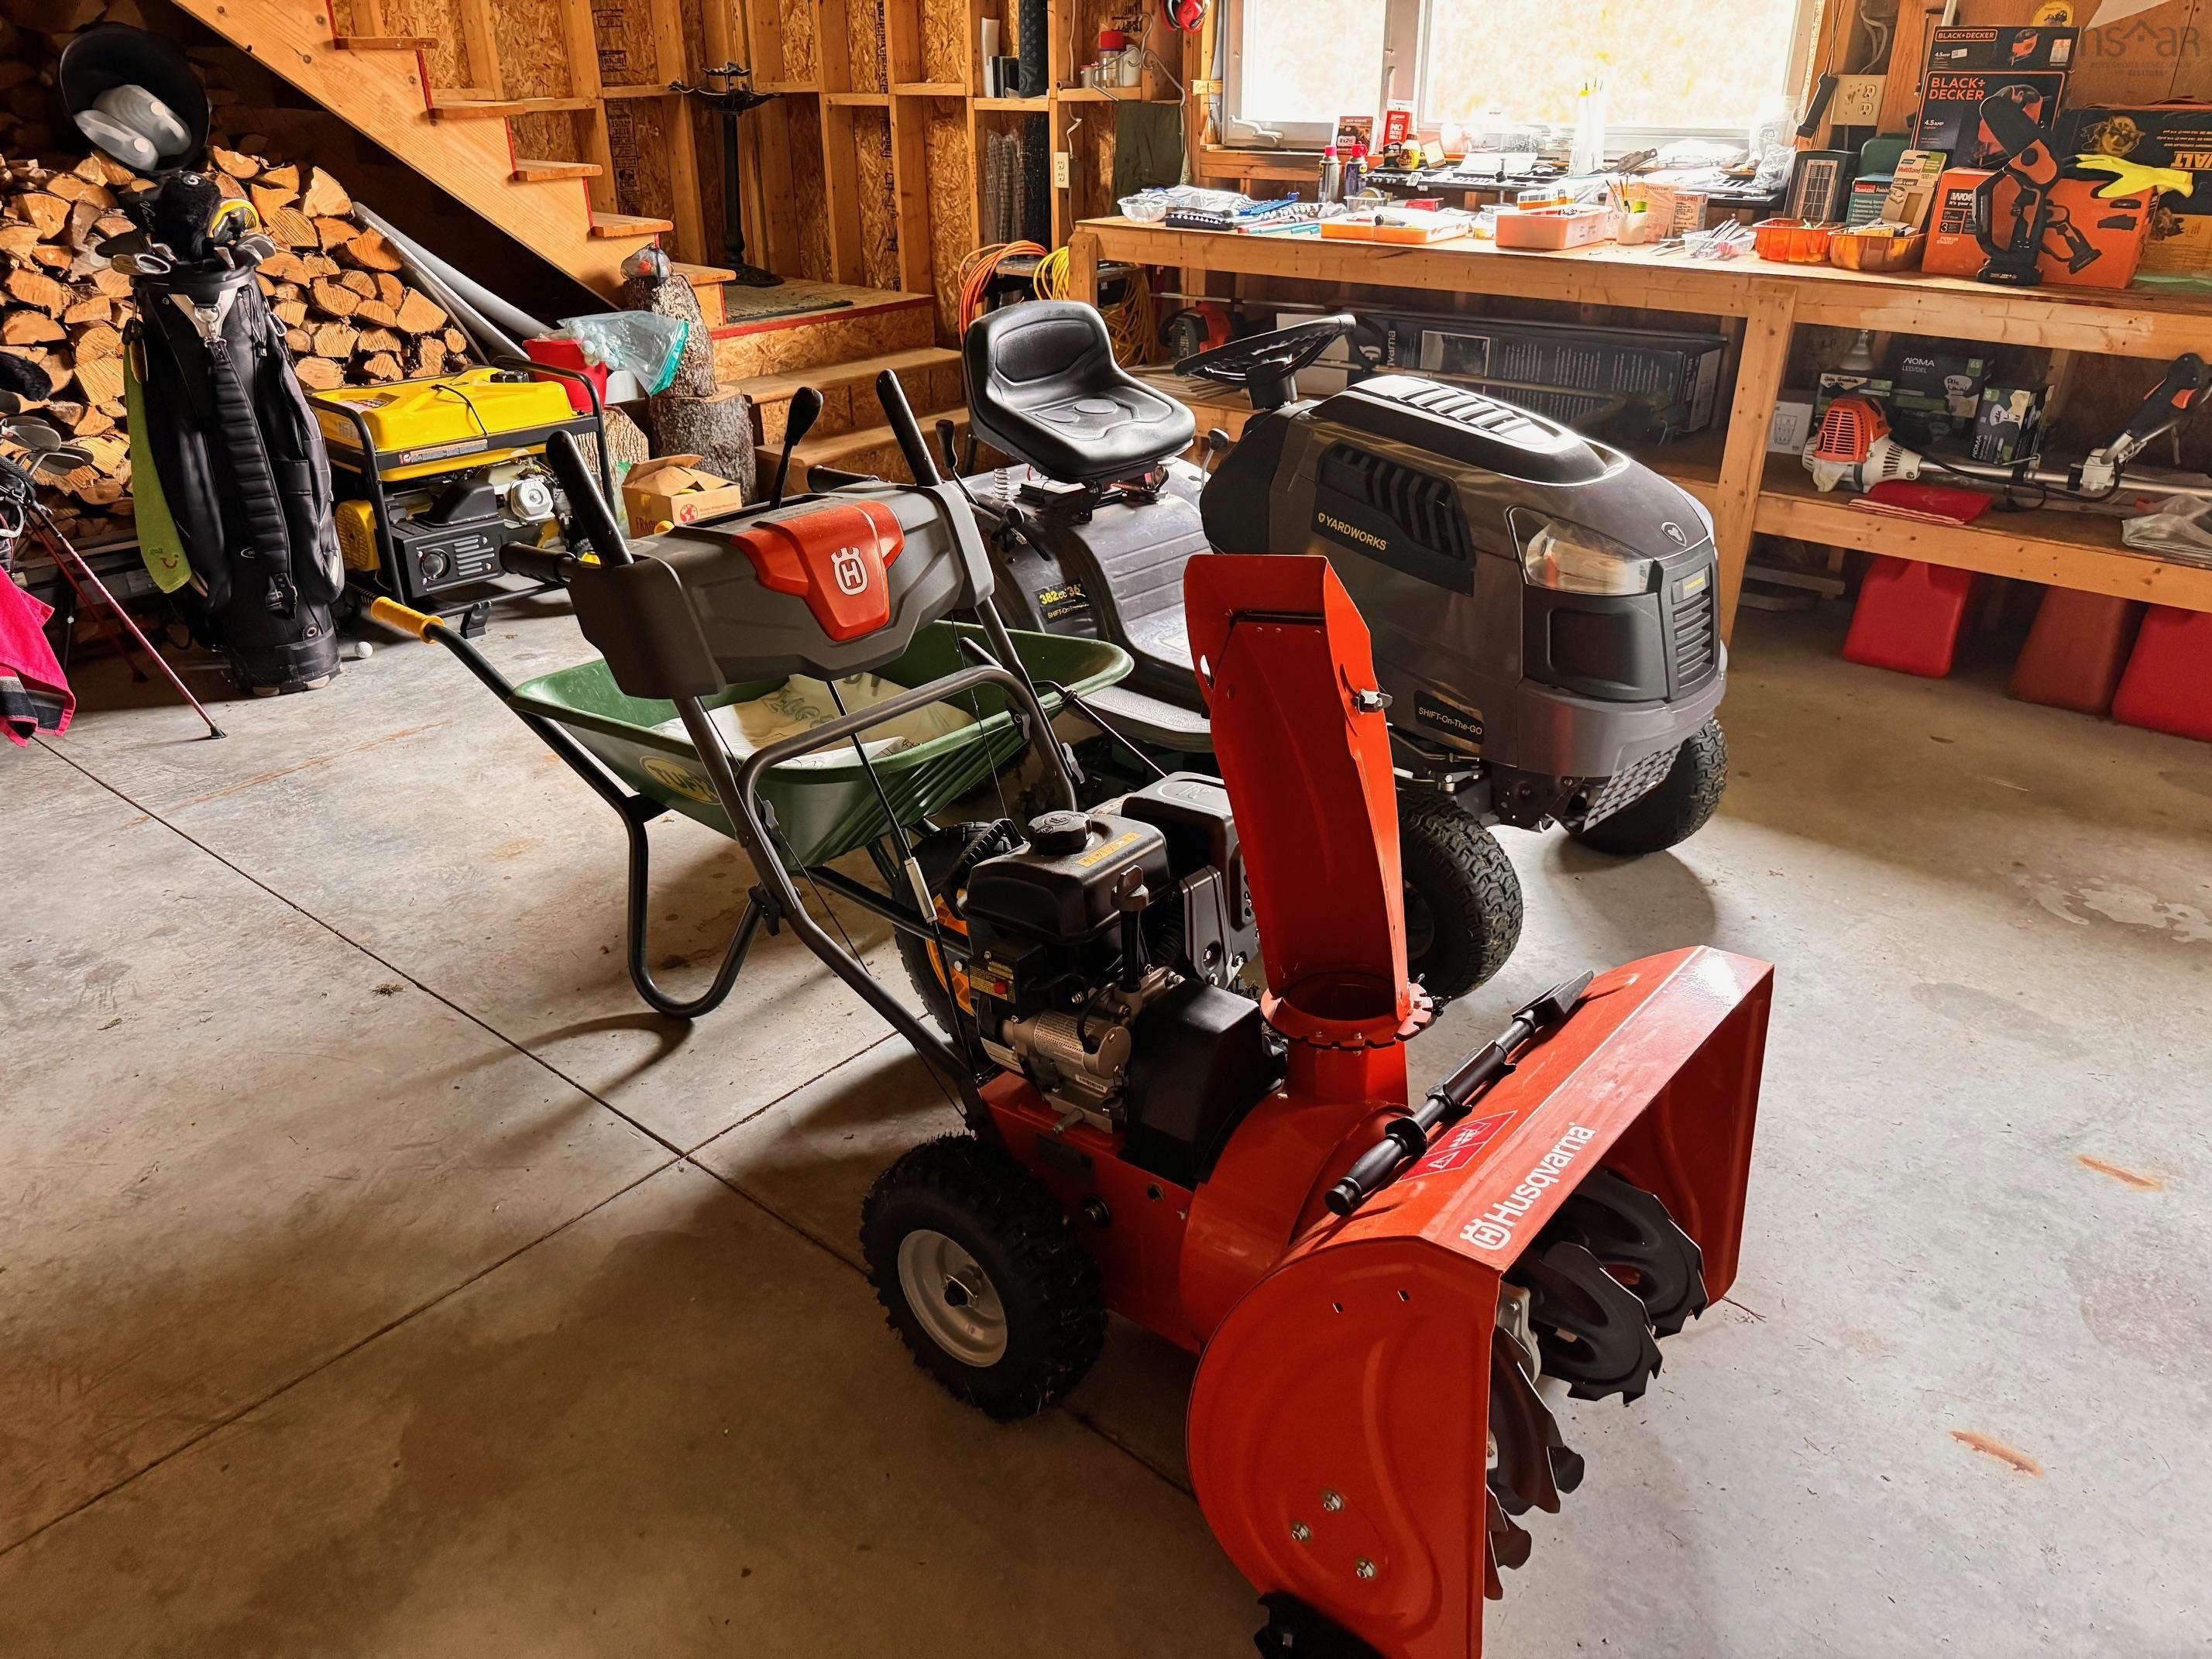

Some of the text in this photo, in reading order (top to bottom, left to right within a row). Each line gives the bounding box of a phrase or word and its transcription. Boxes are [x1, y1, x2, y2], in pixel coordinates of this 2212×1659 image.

[1937, 31, 1995, 40] BLACK+DECKER
[1931, 77, 1987, 89] BLACK+
[1929, 89, 1985, 101] DECKER
[187, 175, 201, 185] 5
[1940, 222, 1949, 232] 3
[1387, 330, 1396, 366] varna
[1903, 357, 1936, 366] NOMA
[1327, 515, 1387, 551] YARDWORKS
[1039, 590, 1068, 605] 382cc
[1418, 706, 1482, 735] SHIFT-On-The-GO
[1482, 1125, 1596, 1228] Husqvarna
